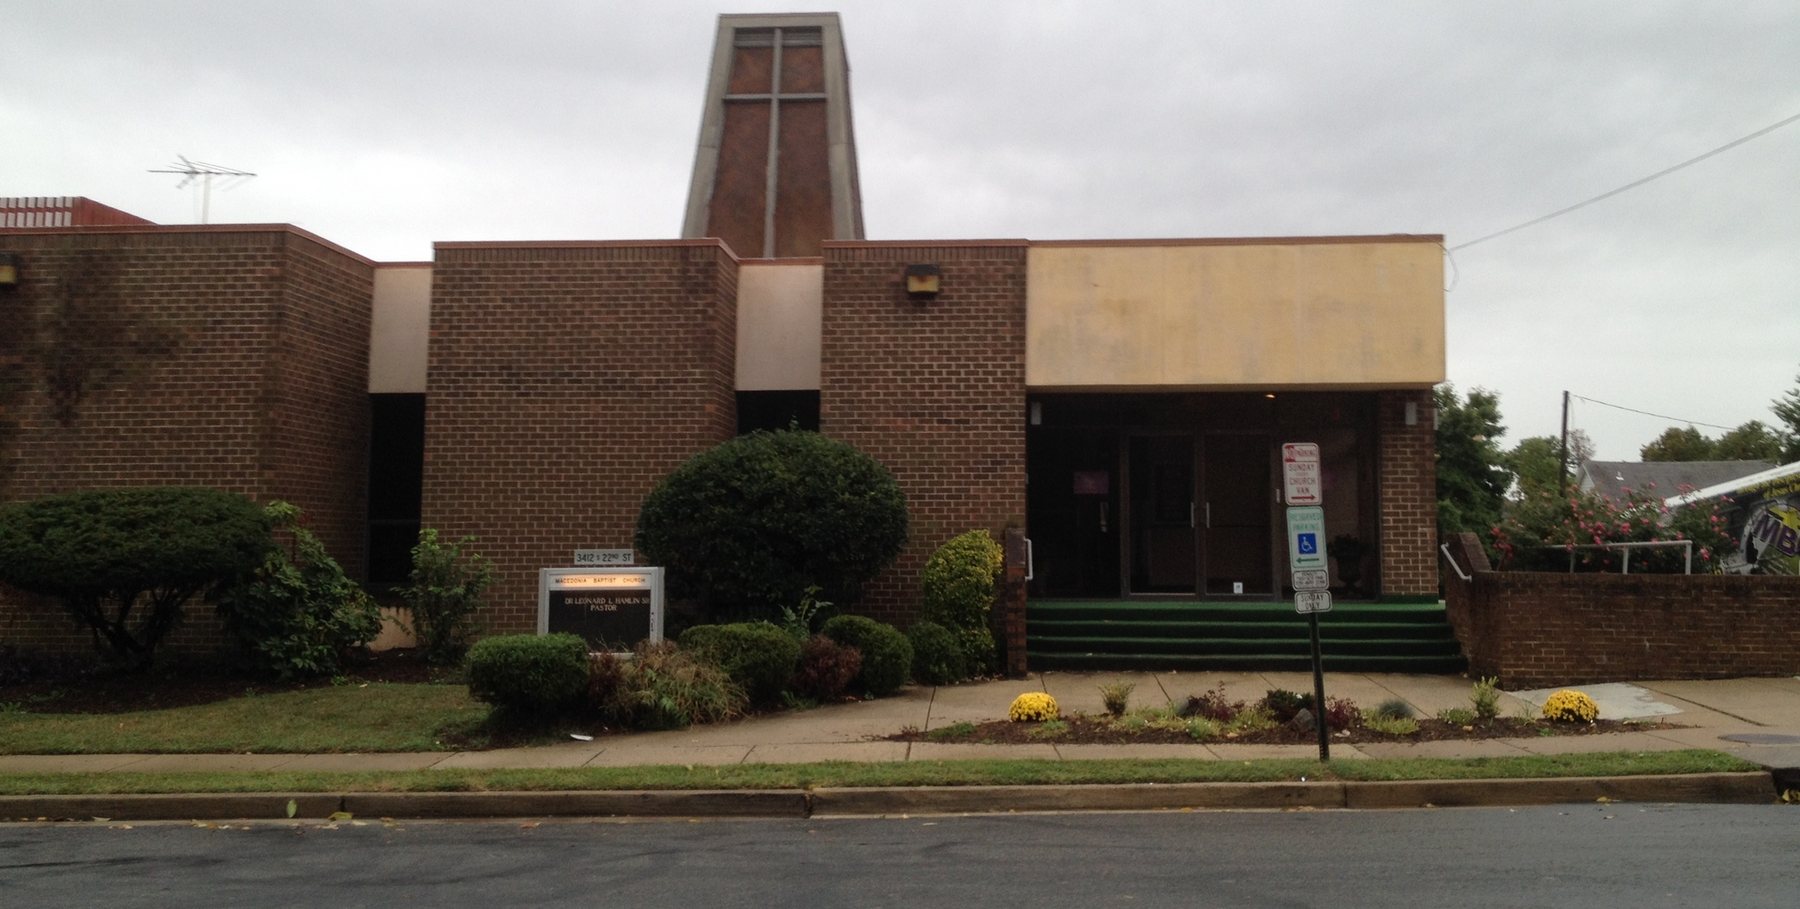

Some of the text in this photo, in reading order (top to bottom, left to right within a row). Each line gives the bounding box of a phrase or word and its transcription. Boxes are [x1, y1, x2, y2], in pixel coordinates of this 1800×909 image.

[1288, 463, 1315, 471] SUNDAY
[1289, 477, 1316, 486] CHURCH
[1296, 486, 1310, 494] VAN
[577, 553, 594, 562] 3412
[623, 553, 632, 562] ST
